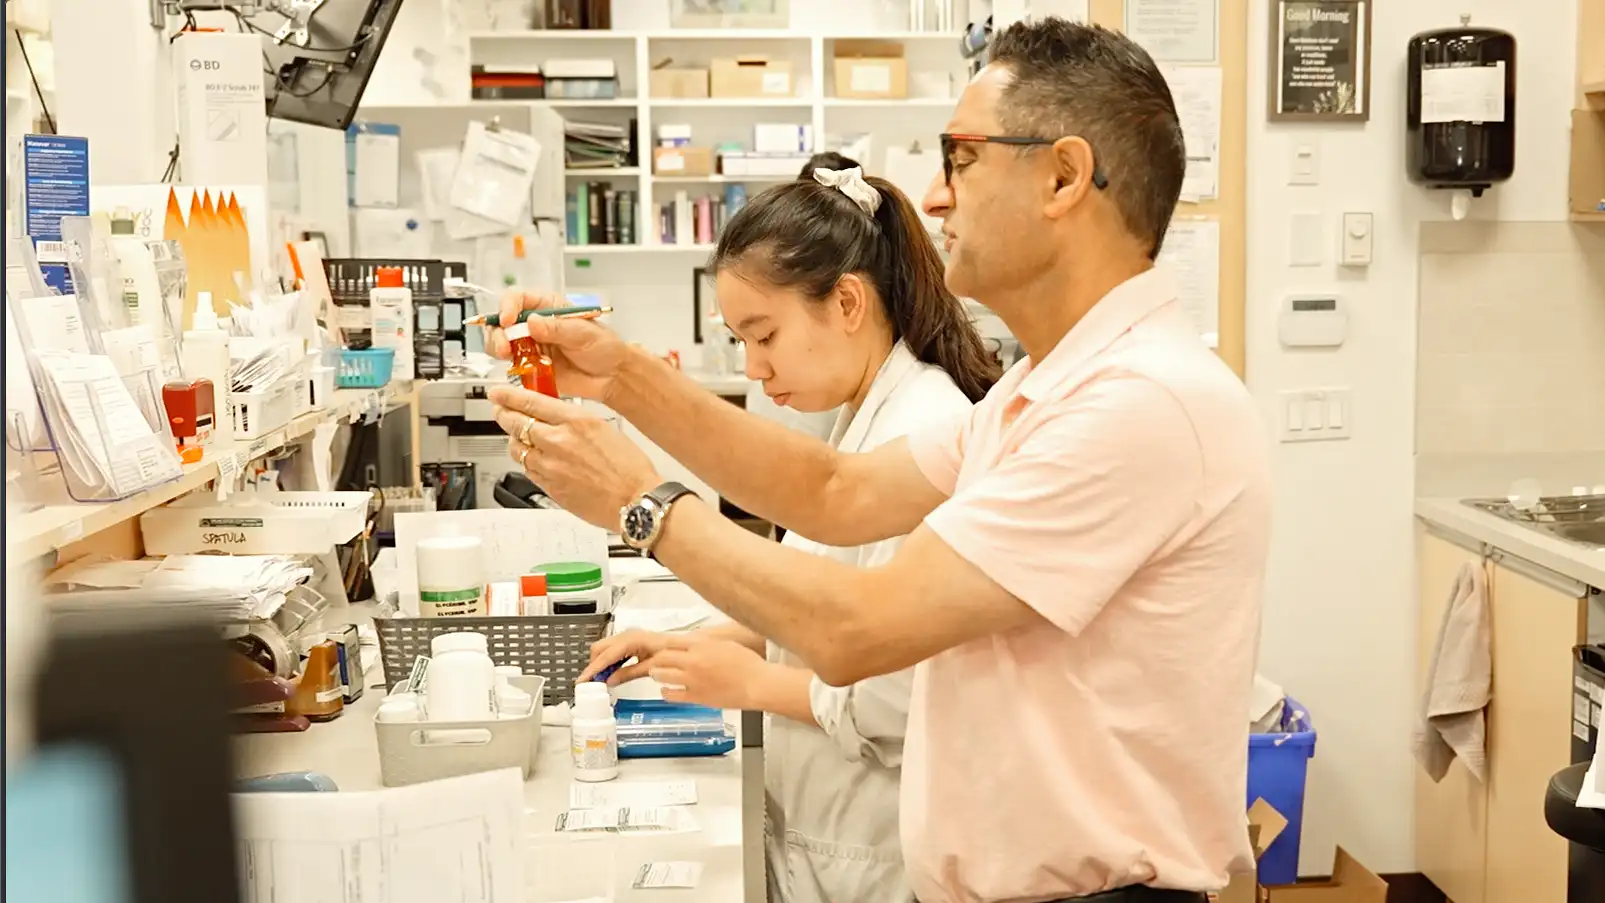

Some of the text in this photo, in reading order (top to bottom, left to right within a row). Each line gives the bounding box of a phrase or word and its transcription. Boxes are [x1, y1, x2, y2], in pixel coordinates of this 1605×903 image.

[1286, 8, 1350, 24] Good Morning
[204, 60, 220, 71] BD
[202, 532, 247, 545] SPATULA
